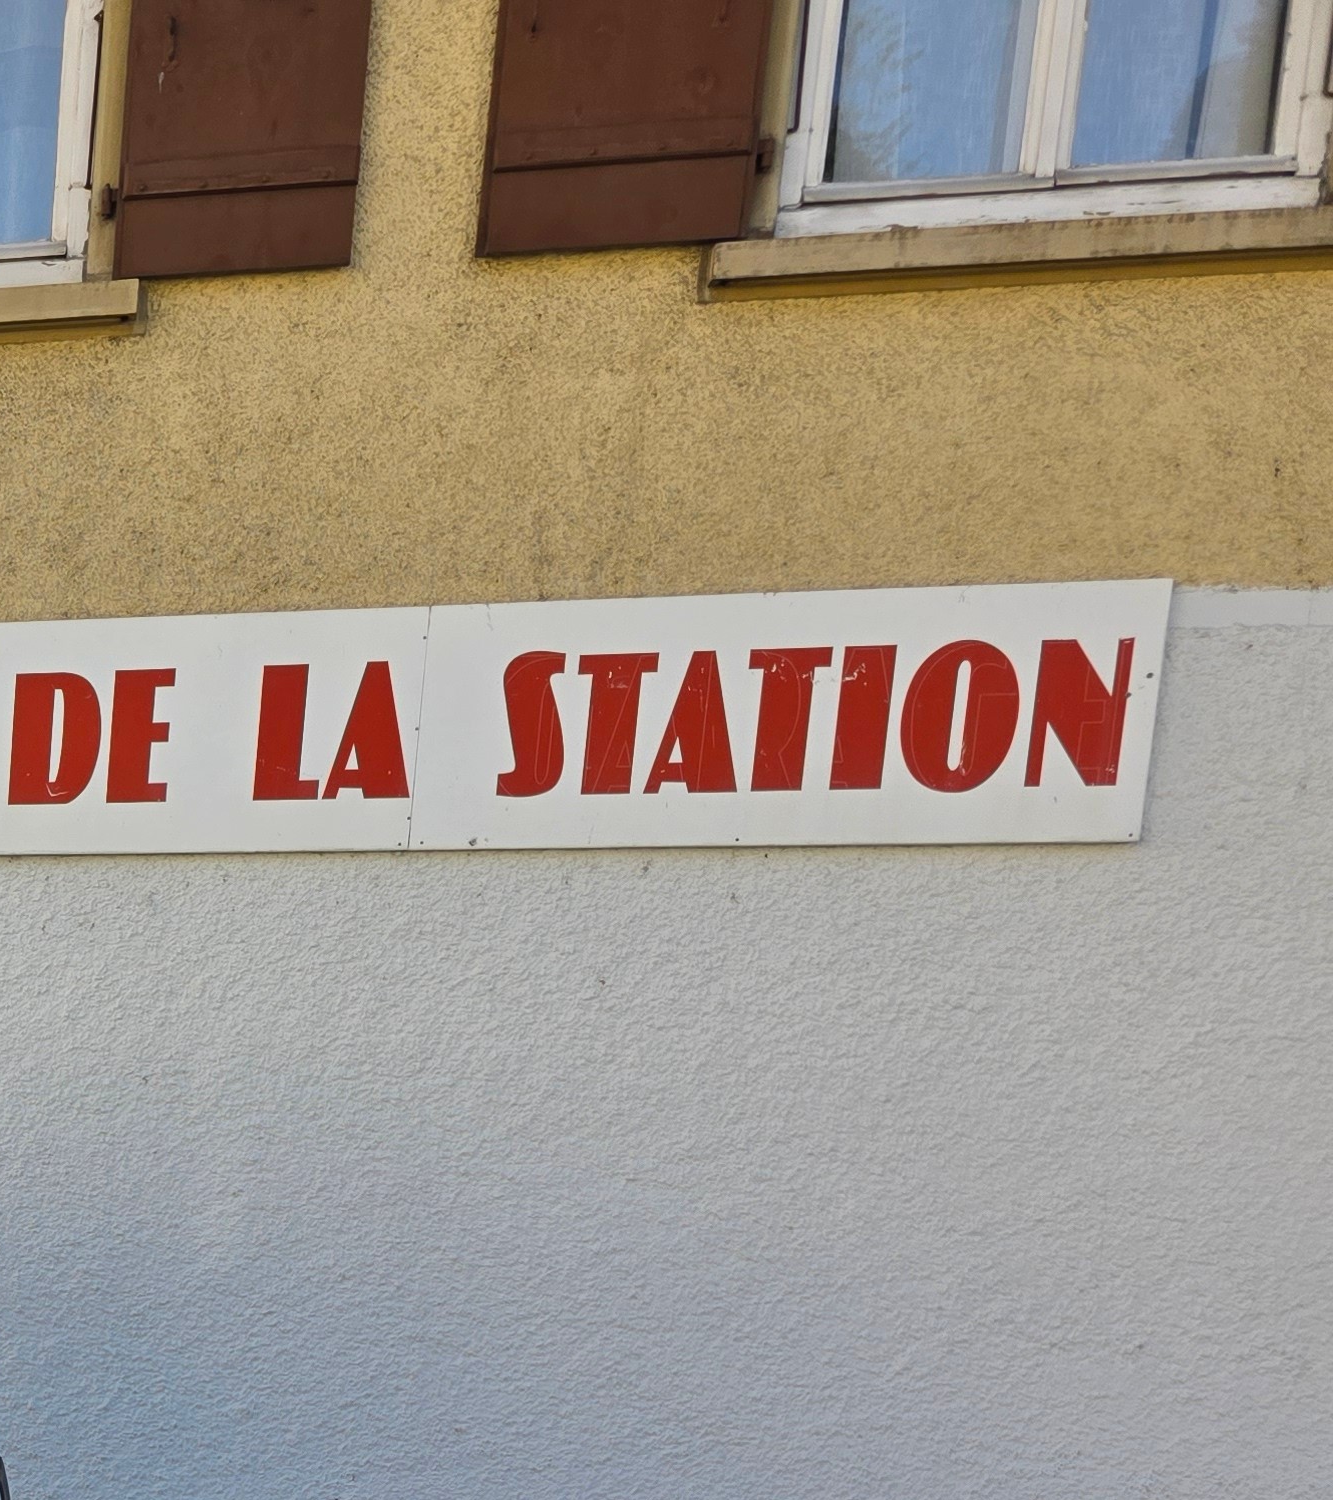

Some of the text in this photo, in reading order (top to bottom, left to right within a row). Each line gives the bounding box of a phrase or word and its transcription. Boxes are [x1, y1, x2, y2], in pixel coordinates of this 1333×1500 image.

[8, 667, 177, 806] DE
[252, 660, 410, 800] LA
[495, 637, 1136, 797] STATION
